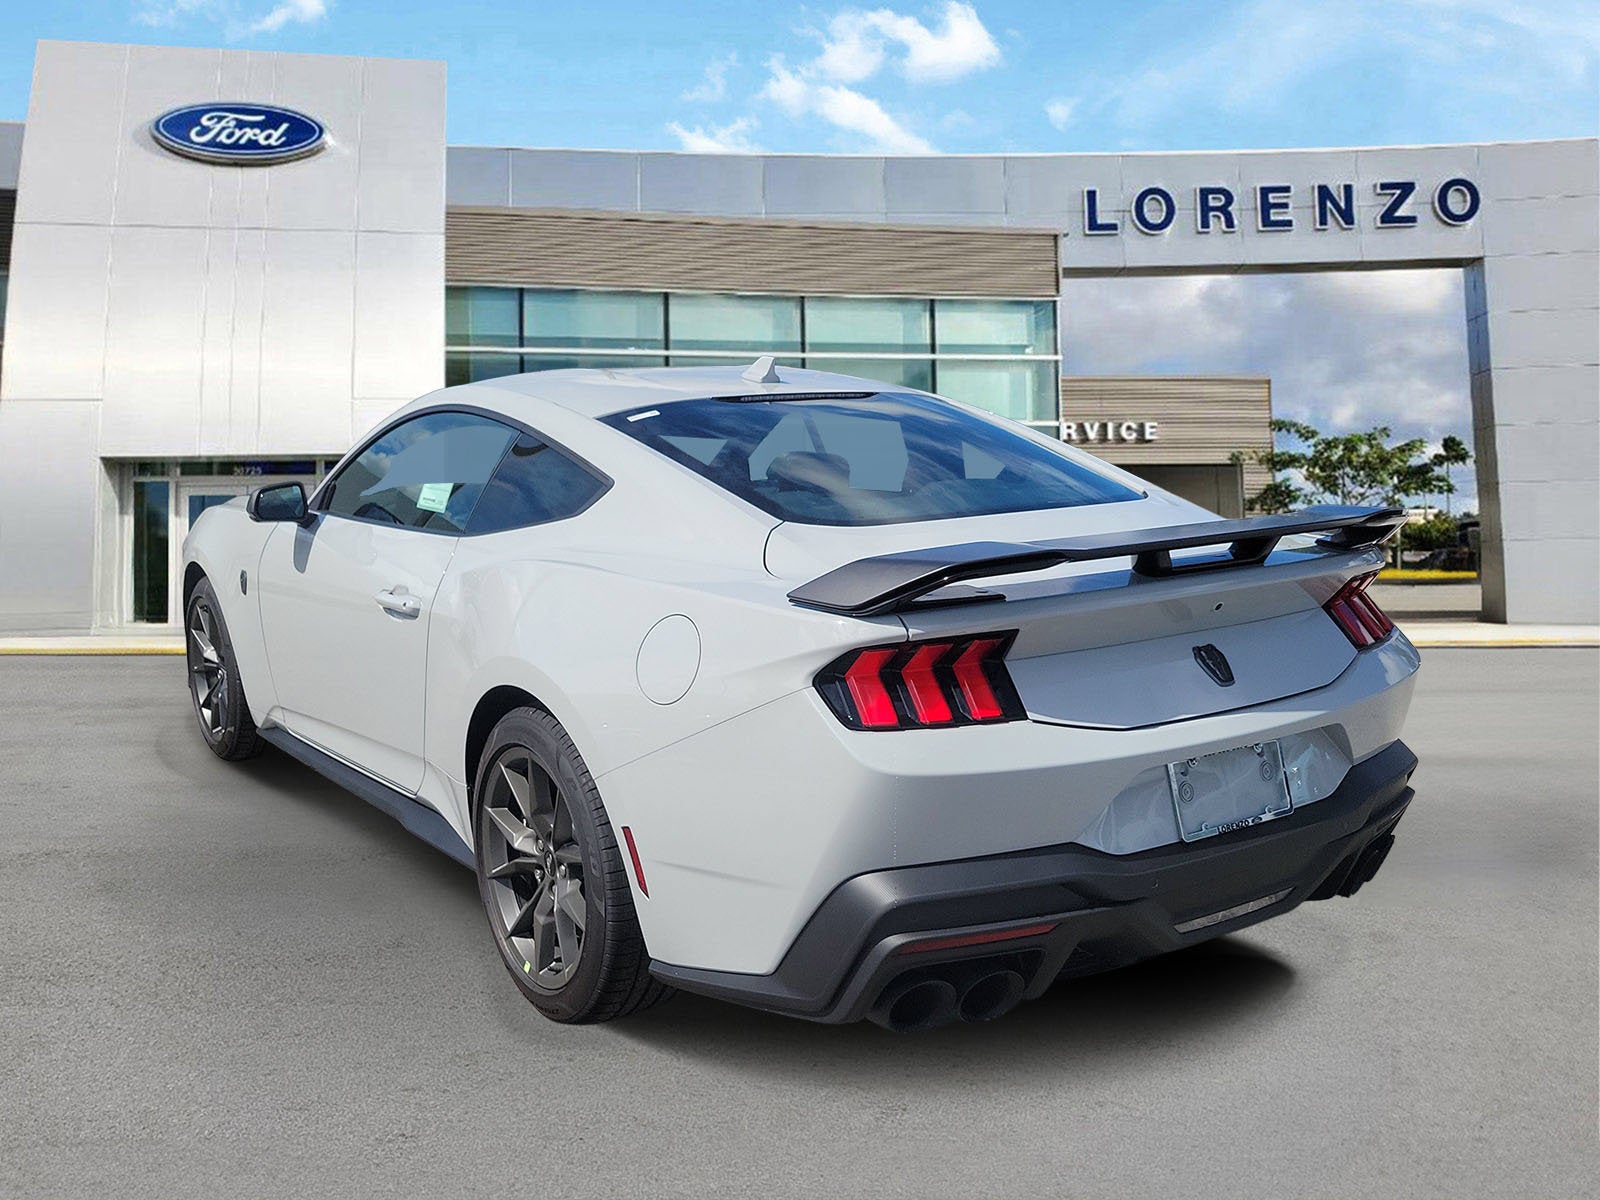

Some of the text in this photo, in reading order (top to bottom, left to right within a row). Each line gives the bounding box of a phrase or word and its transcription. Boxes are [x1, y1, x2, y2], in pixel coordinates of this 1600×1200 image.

[190, 111, 289, 146] Ford
[1083, 178, 1481, 235] LORENZO
[1061, 421, 1159, 441] RVICE
[1217, 819, 1250, 835] LORENZO
